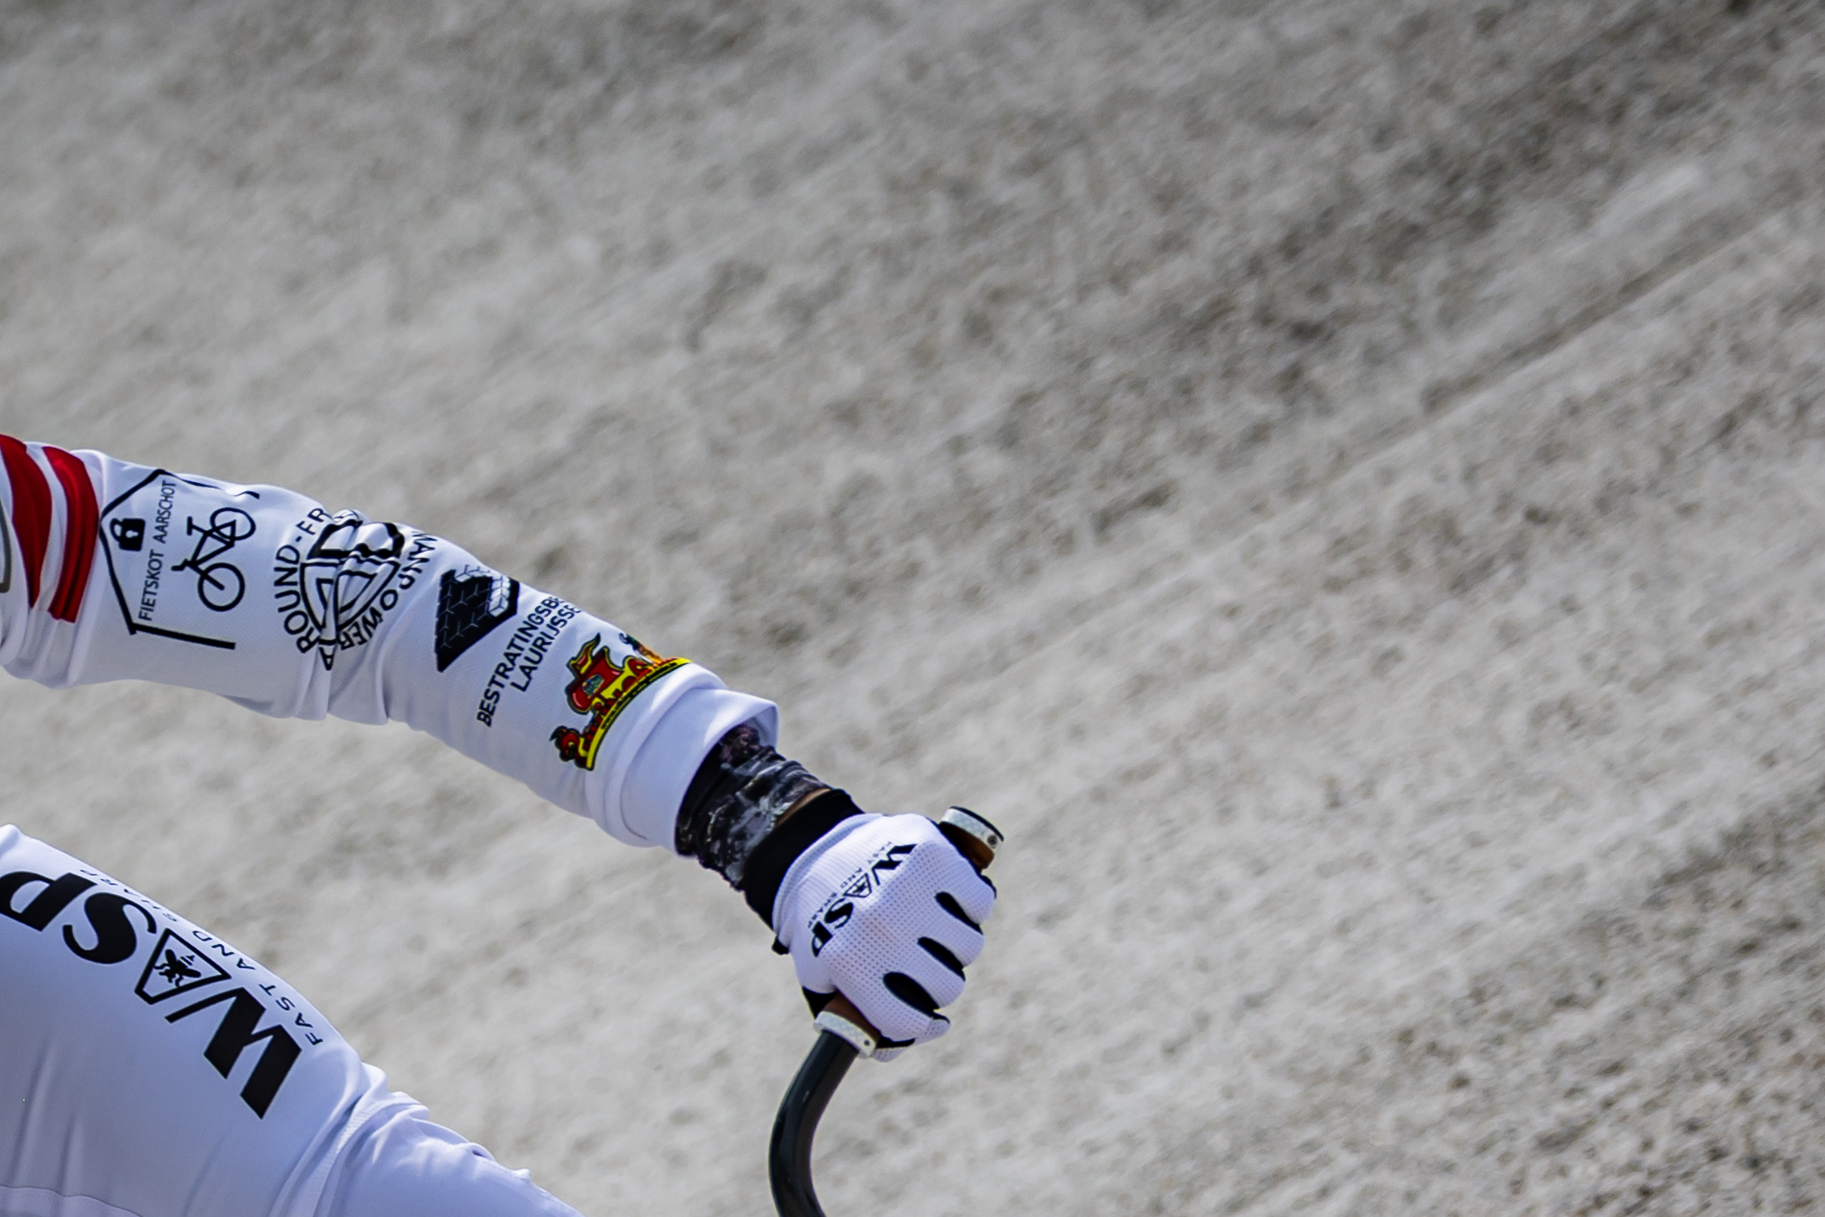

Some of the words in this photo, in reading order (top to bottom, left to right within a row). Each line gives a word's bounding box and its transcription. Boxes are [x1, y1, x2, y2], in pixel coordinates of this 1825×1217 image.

[137, 548, 164, 622] FIETSKOT
[152, 479, 177, 545] AARSCHOT
[476, 593, 568, 727] BESTRATINGSB
[810, 843, 918, 958] WASP
[840, 867, 864, 890] AND
[192, 929, 256, 972] AND
[260, 982, 324, 1047] FAST
